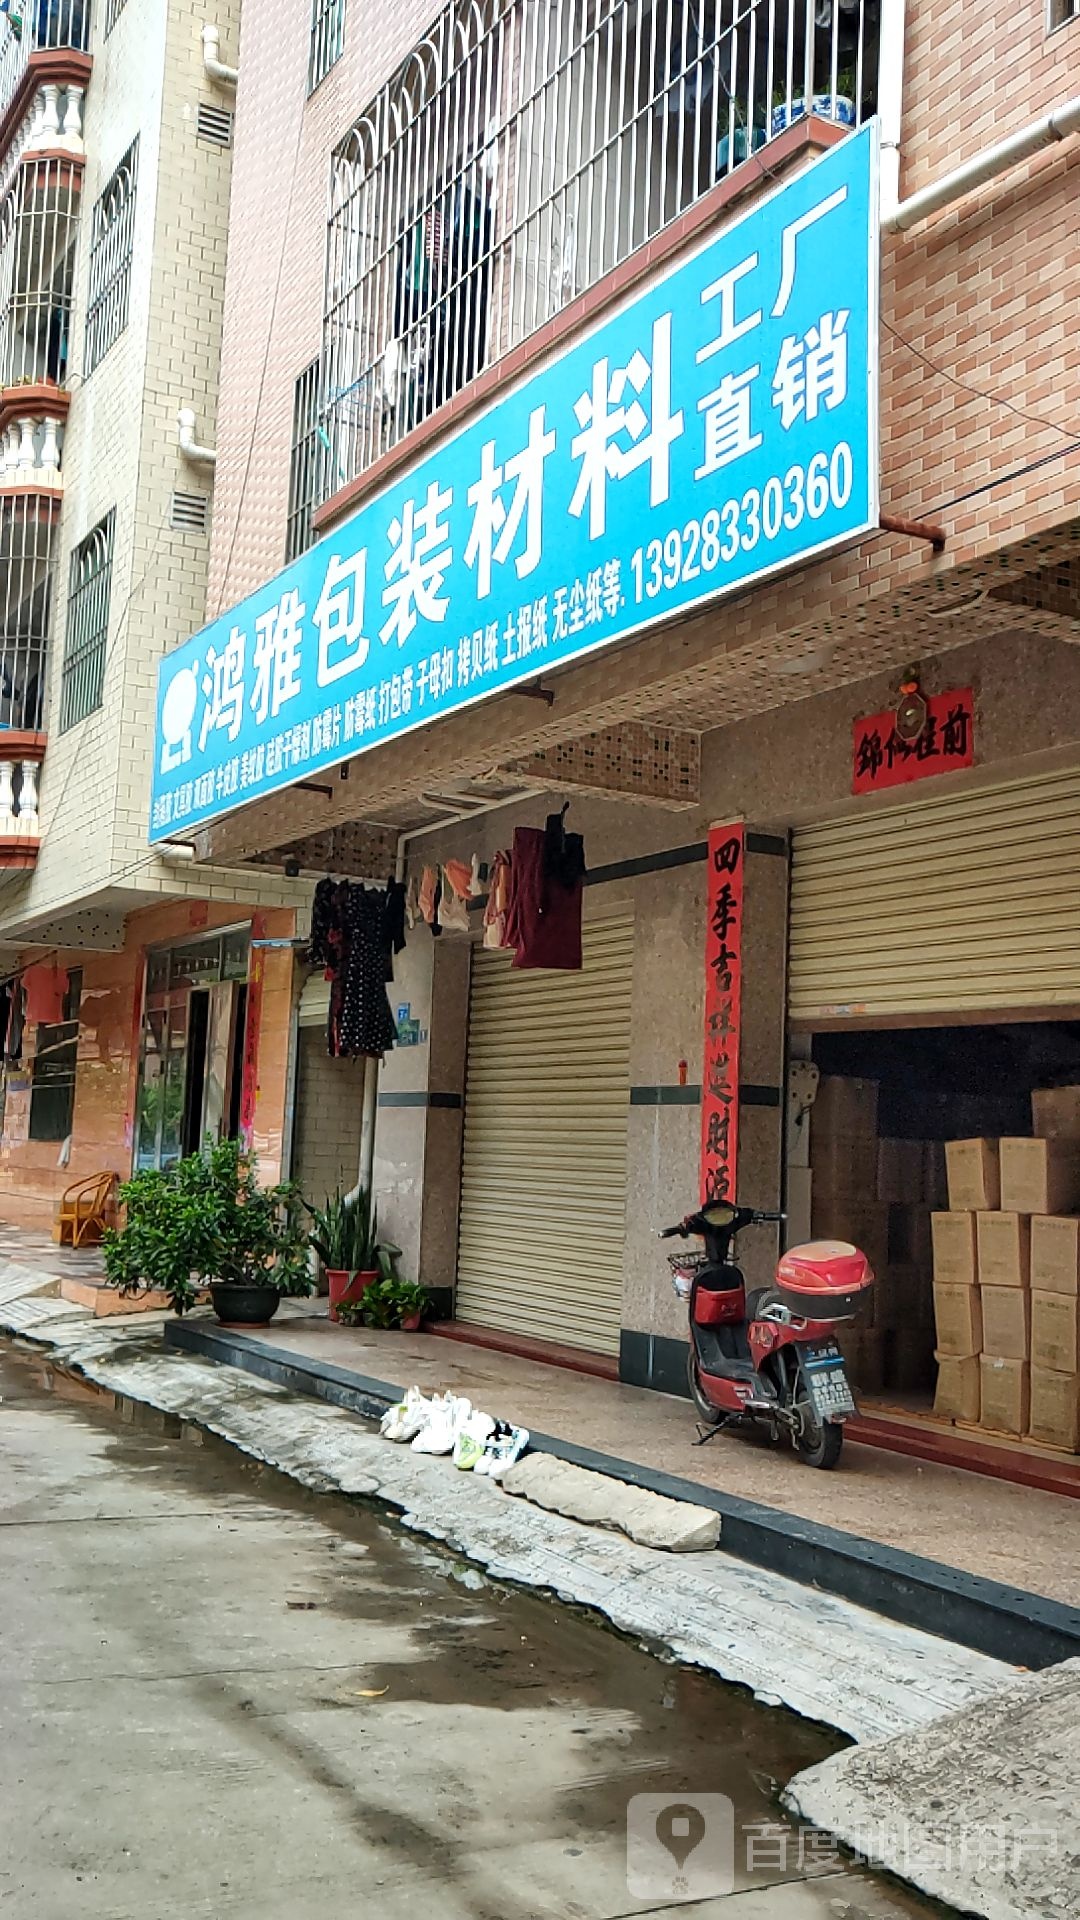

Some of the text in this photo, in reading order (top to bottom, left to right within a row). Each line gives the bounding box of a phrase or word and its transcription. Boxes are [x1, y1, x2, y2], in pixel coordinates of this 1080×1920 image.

[695, 185, 848, 366] 工厂
[694, 309, 851, 481] 直销
[198, 310, 685, 752] 鸿雅包装材料
[630, 441, 854, 604] 13928330360
[378, 664, 414, 727] 打包带
[416, 645, 454, 706] 子母扣
[457, 620, 498, 688] 拷贝纸
[501, 594, 548, 666] 土报纸
